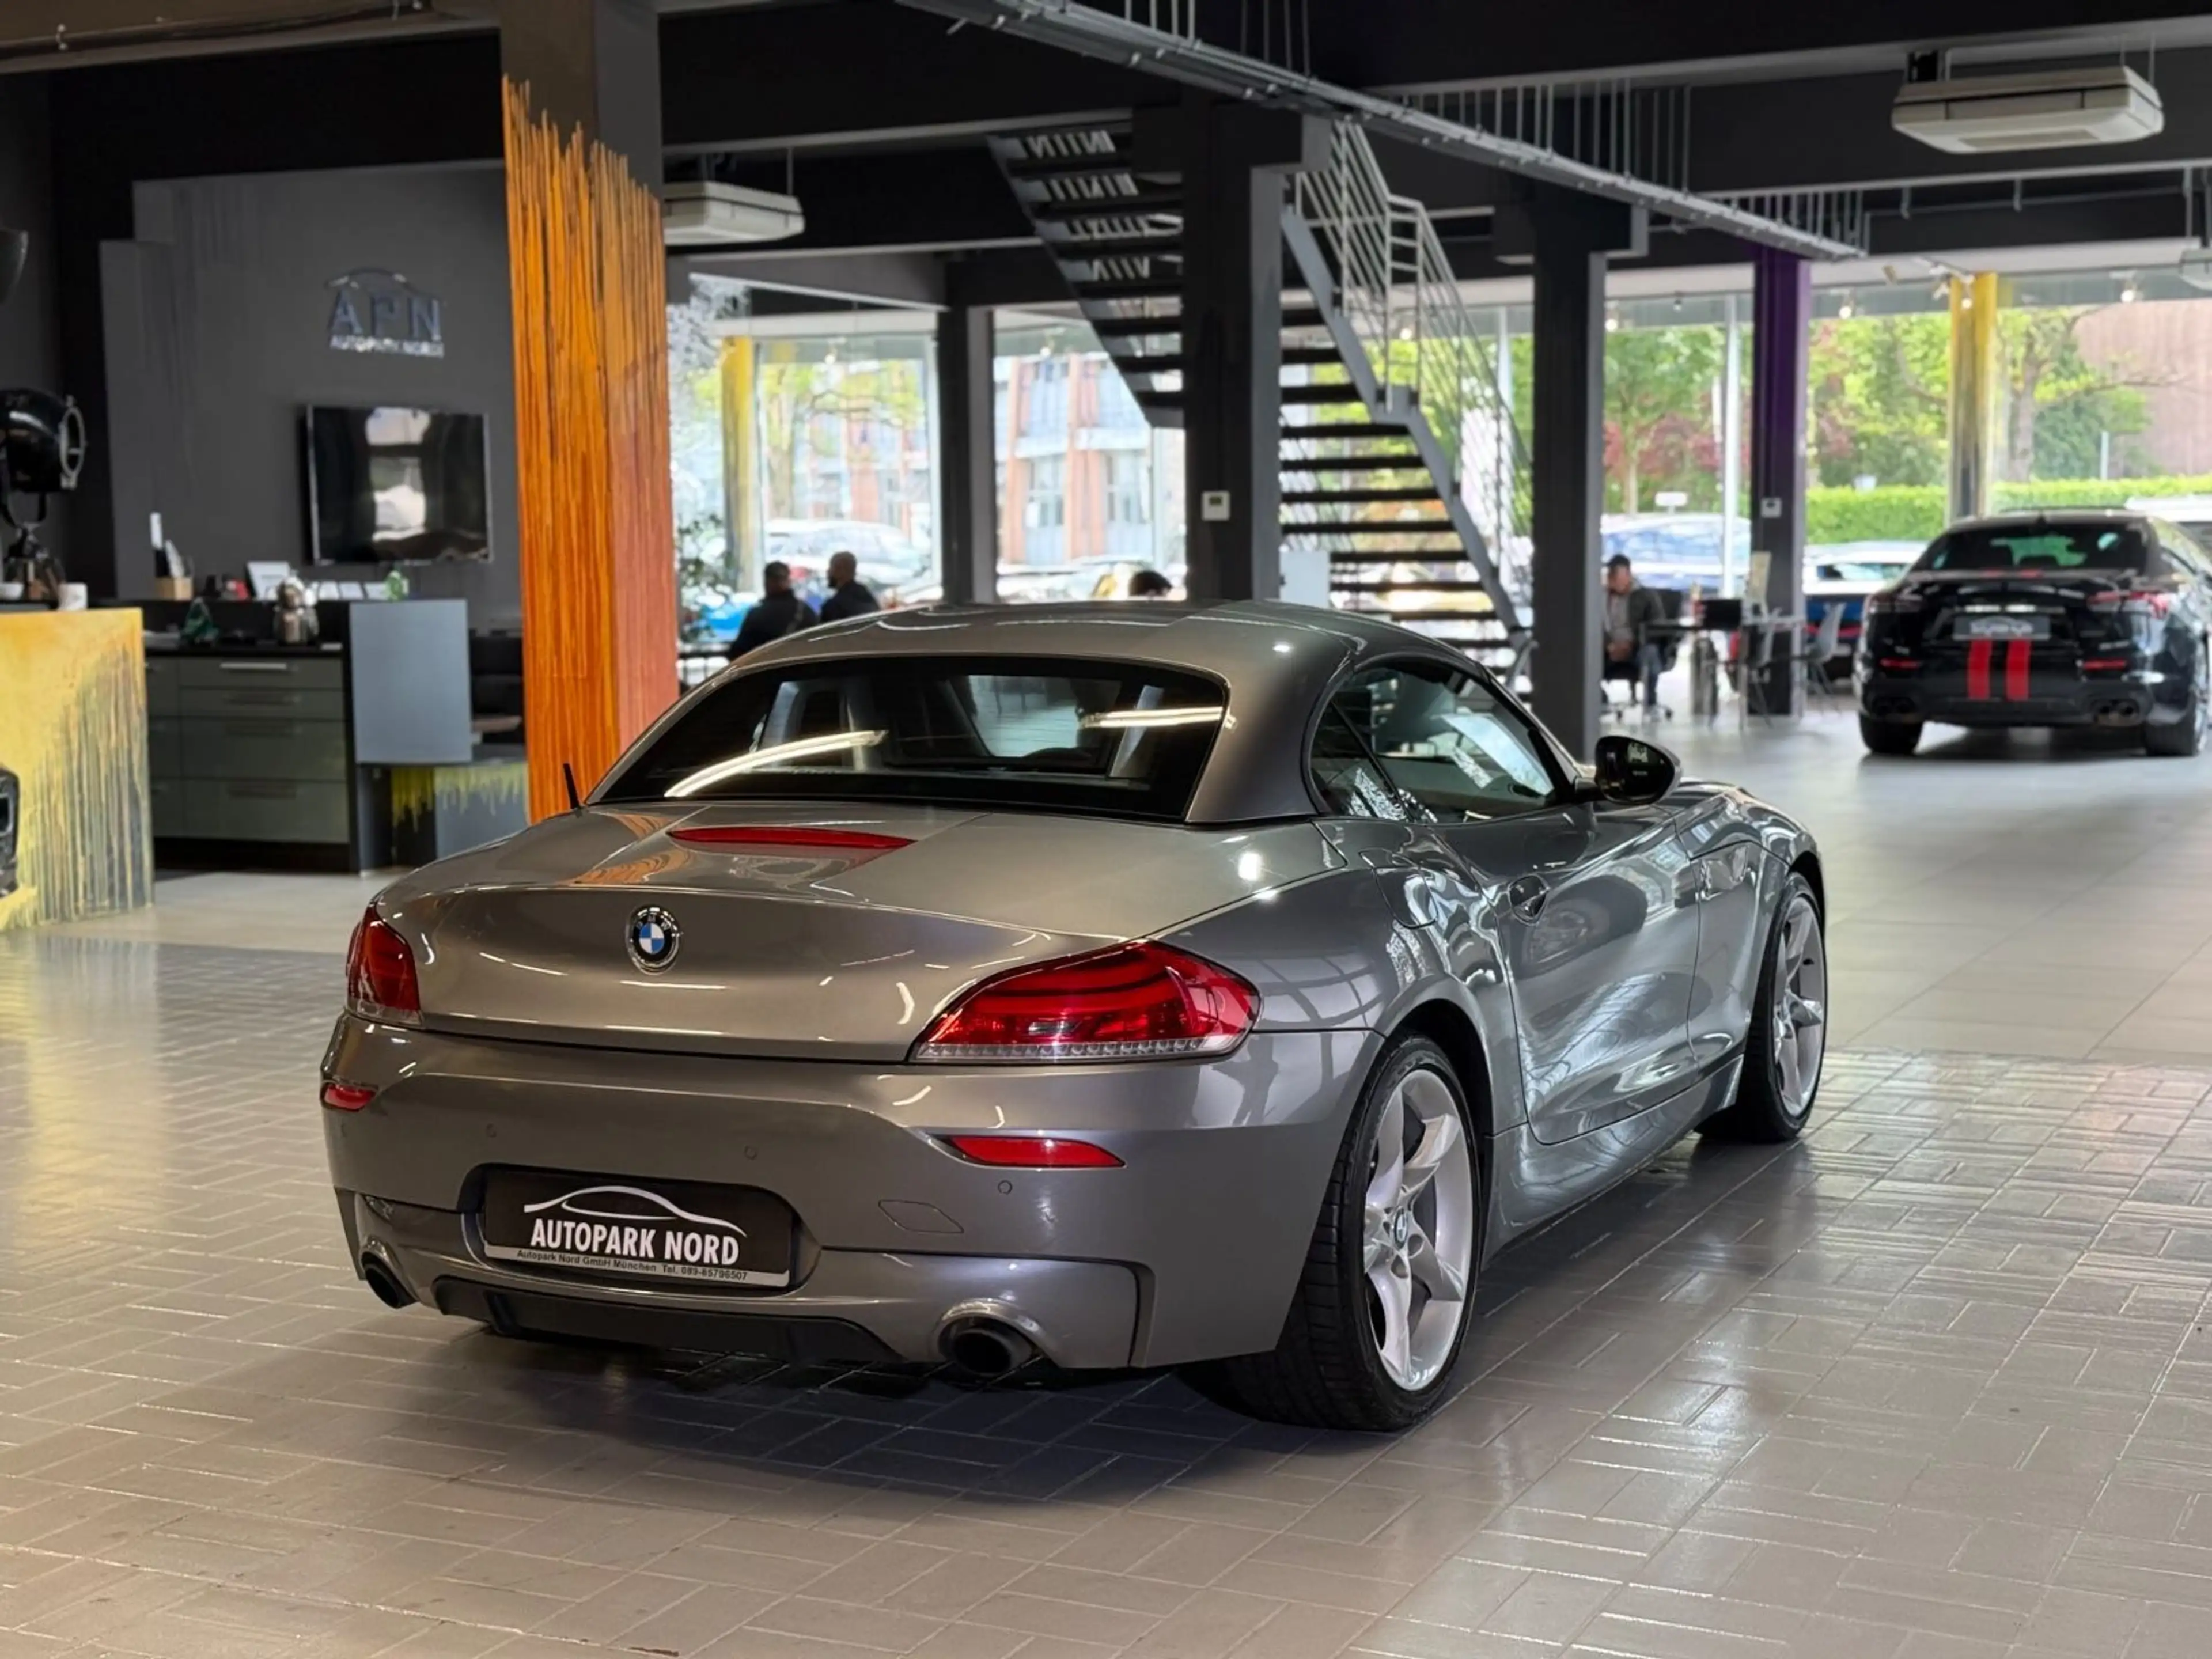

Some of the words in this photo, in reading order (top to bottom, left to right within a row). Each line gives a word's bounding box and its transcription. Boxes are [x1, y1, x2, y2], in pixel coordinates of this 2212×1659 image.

[328, 288, 441, 341] APN
[517, 1249, 557, 1262] Autopark
[559, 1255, 581, 1264] Nord
[582, 1257, 611, 1266] GmbH
[614, 1260, 657, 1271] München
[662, 1264, 679, 1274] Tel.
[531, 1218, 656, 1258] AUTOPARK
[664, 1230, 739, 1266] NORD
